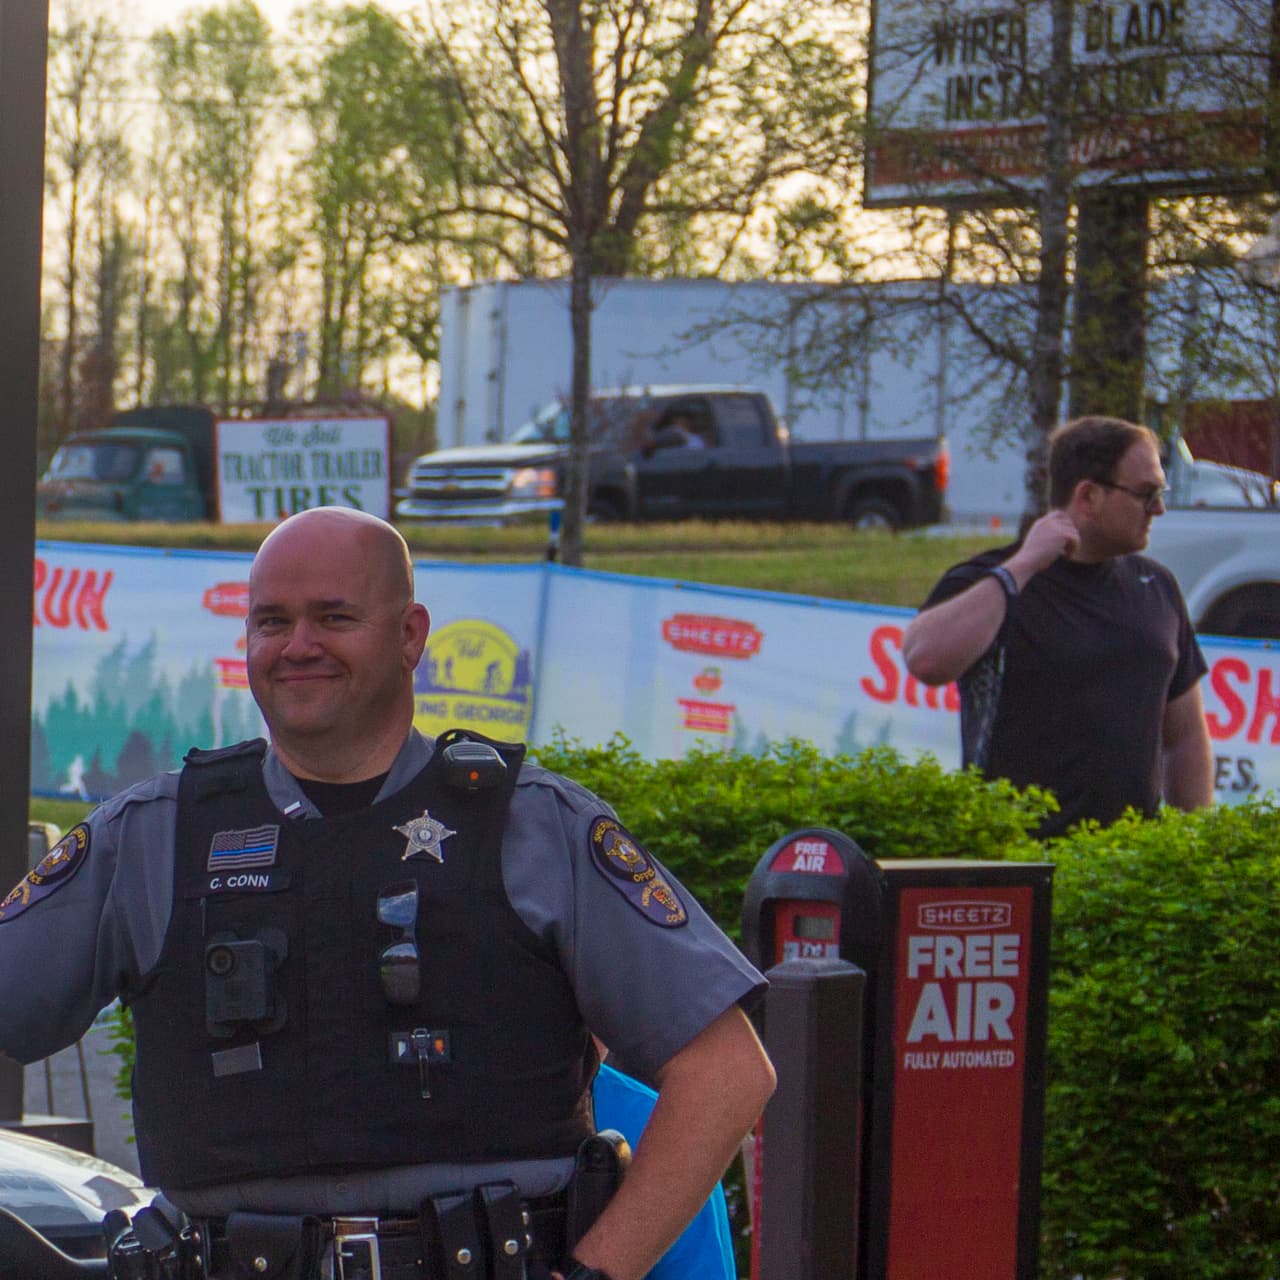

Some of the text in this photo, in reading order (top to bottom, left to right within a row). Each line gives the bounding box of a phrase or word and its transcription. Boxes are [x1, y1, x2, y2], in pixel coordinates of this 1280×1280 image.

[224, 449, 384, 481] TRACTOR TRAILER
[795, 842, 828, 855] FREE
[792, 855, 825, 872] AIR
[227, 875, 269, 887] CONN
[925, 908, 1005, 923] SHEETZ
[907, 934, 1021, 978] FREE
[906, 982, 1015, 1043] AIR
[904, 1050, 1015, 1069] FULLY AUTOMATED
